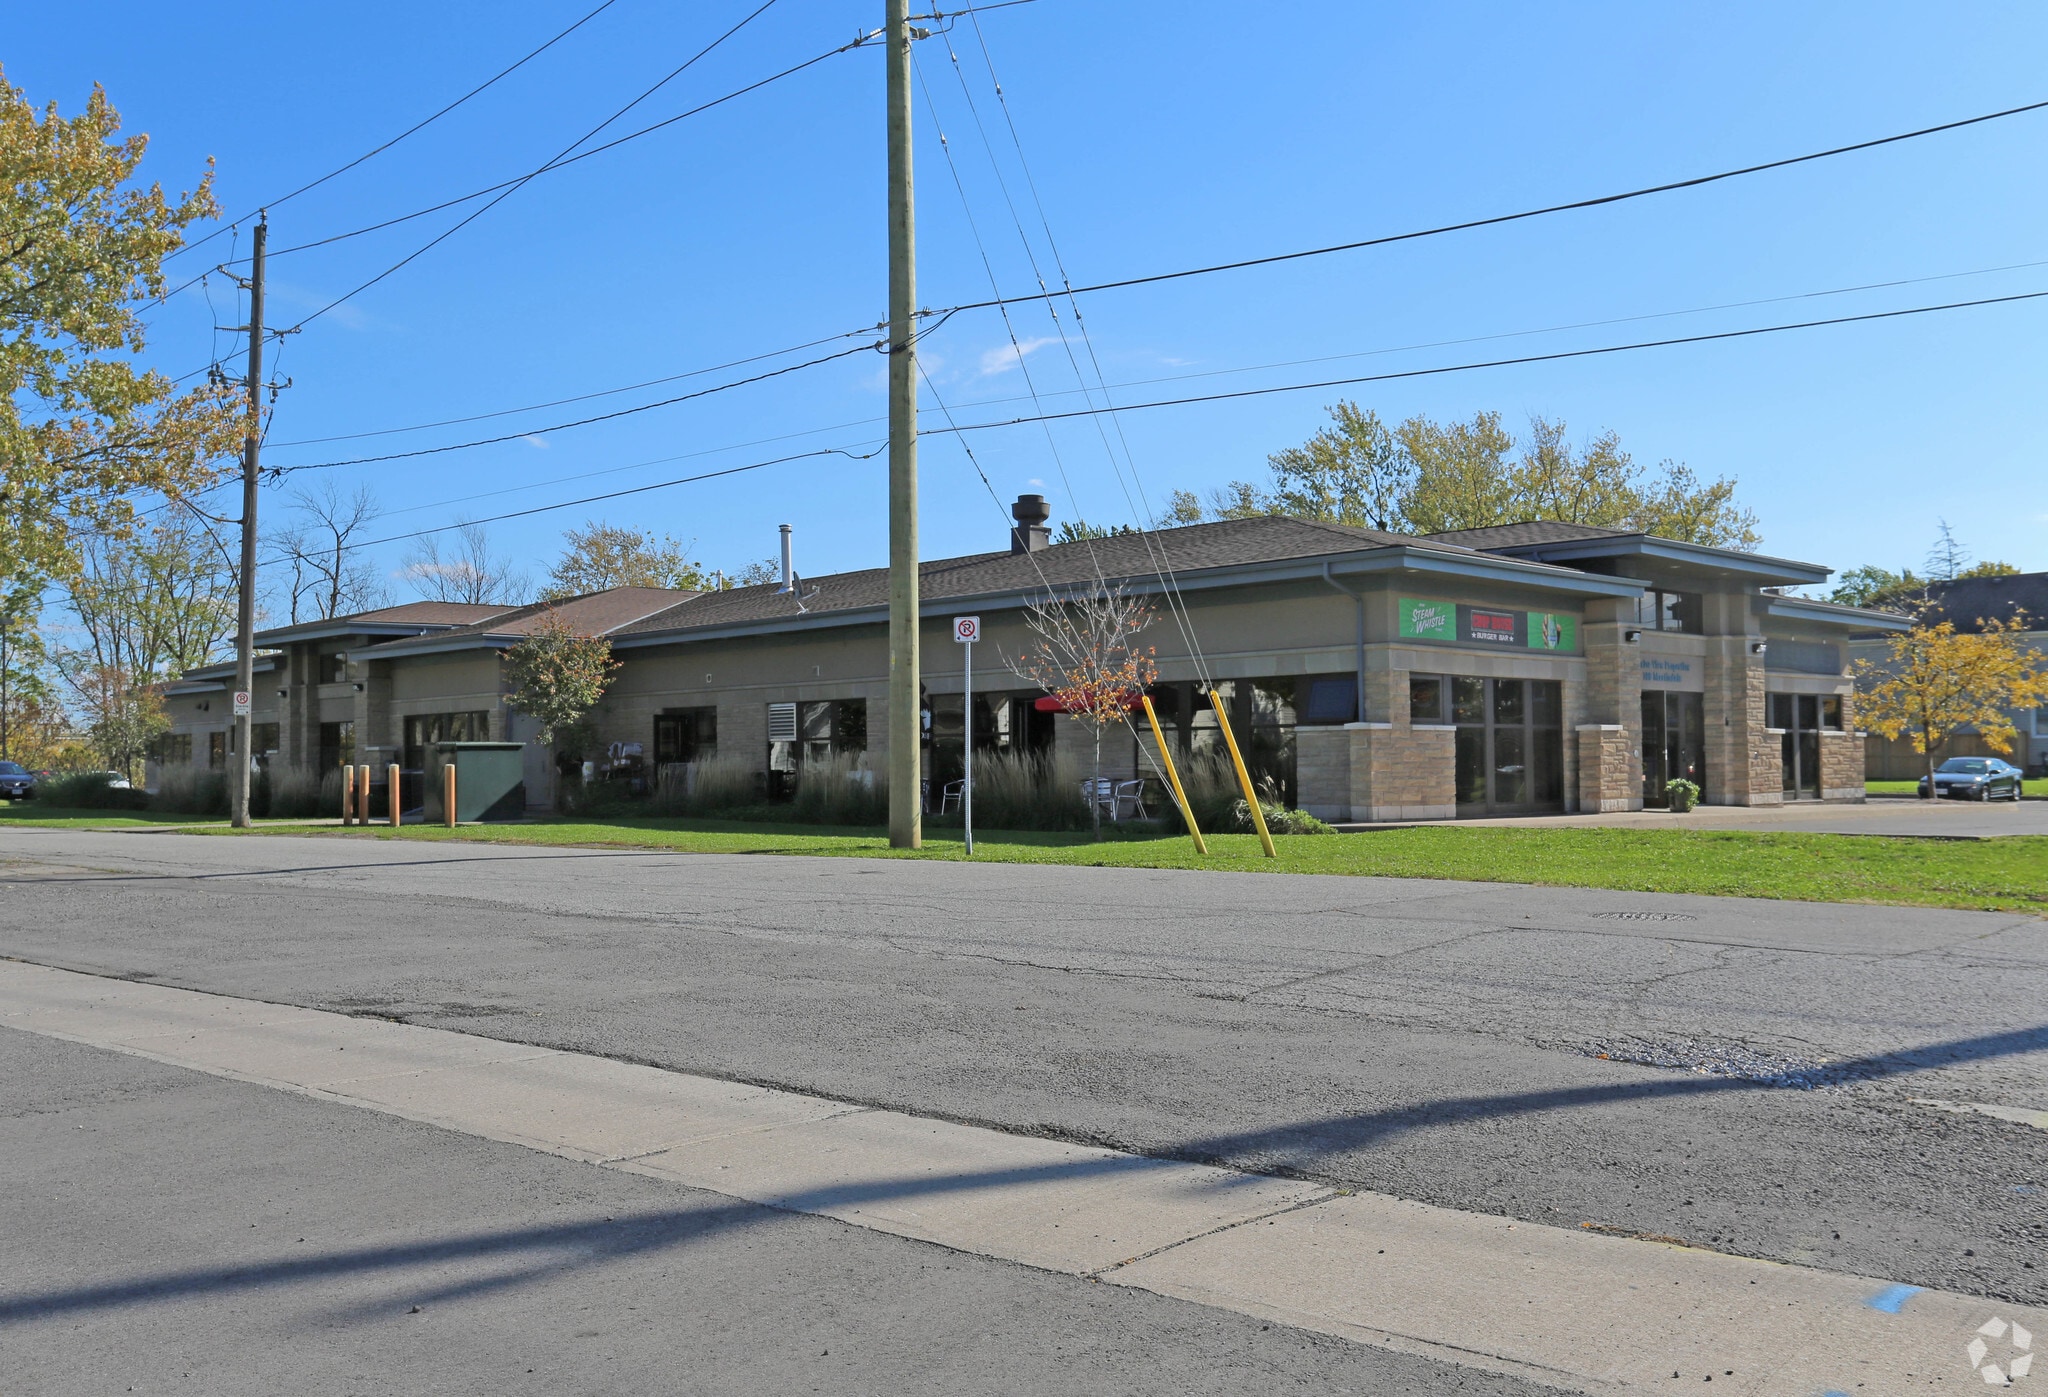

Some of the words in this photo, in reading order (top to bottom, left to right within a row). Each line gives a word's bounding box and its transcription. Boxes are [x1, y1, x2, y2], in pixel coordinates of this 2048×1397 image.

[1412, 608, 1435, 622] STEAM
[1416, 615, 1446, 634] WHISTLE
[1476, 632, 1498, 641] BURGER
[1498, 634, 1510, 642] BAR
